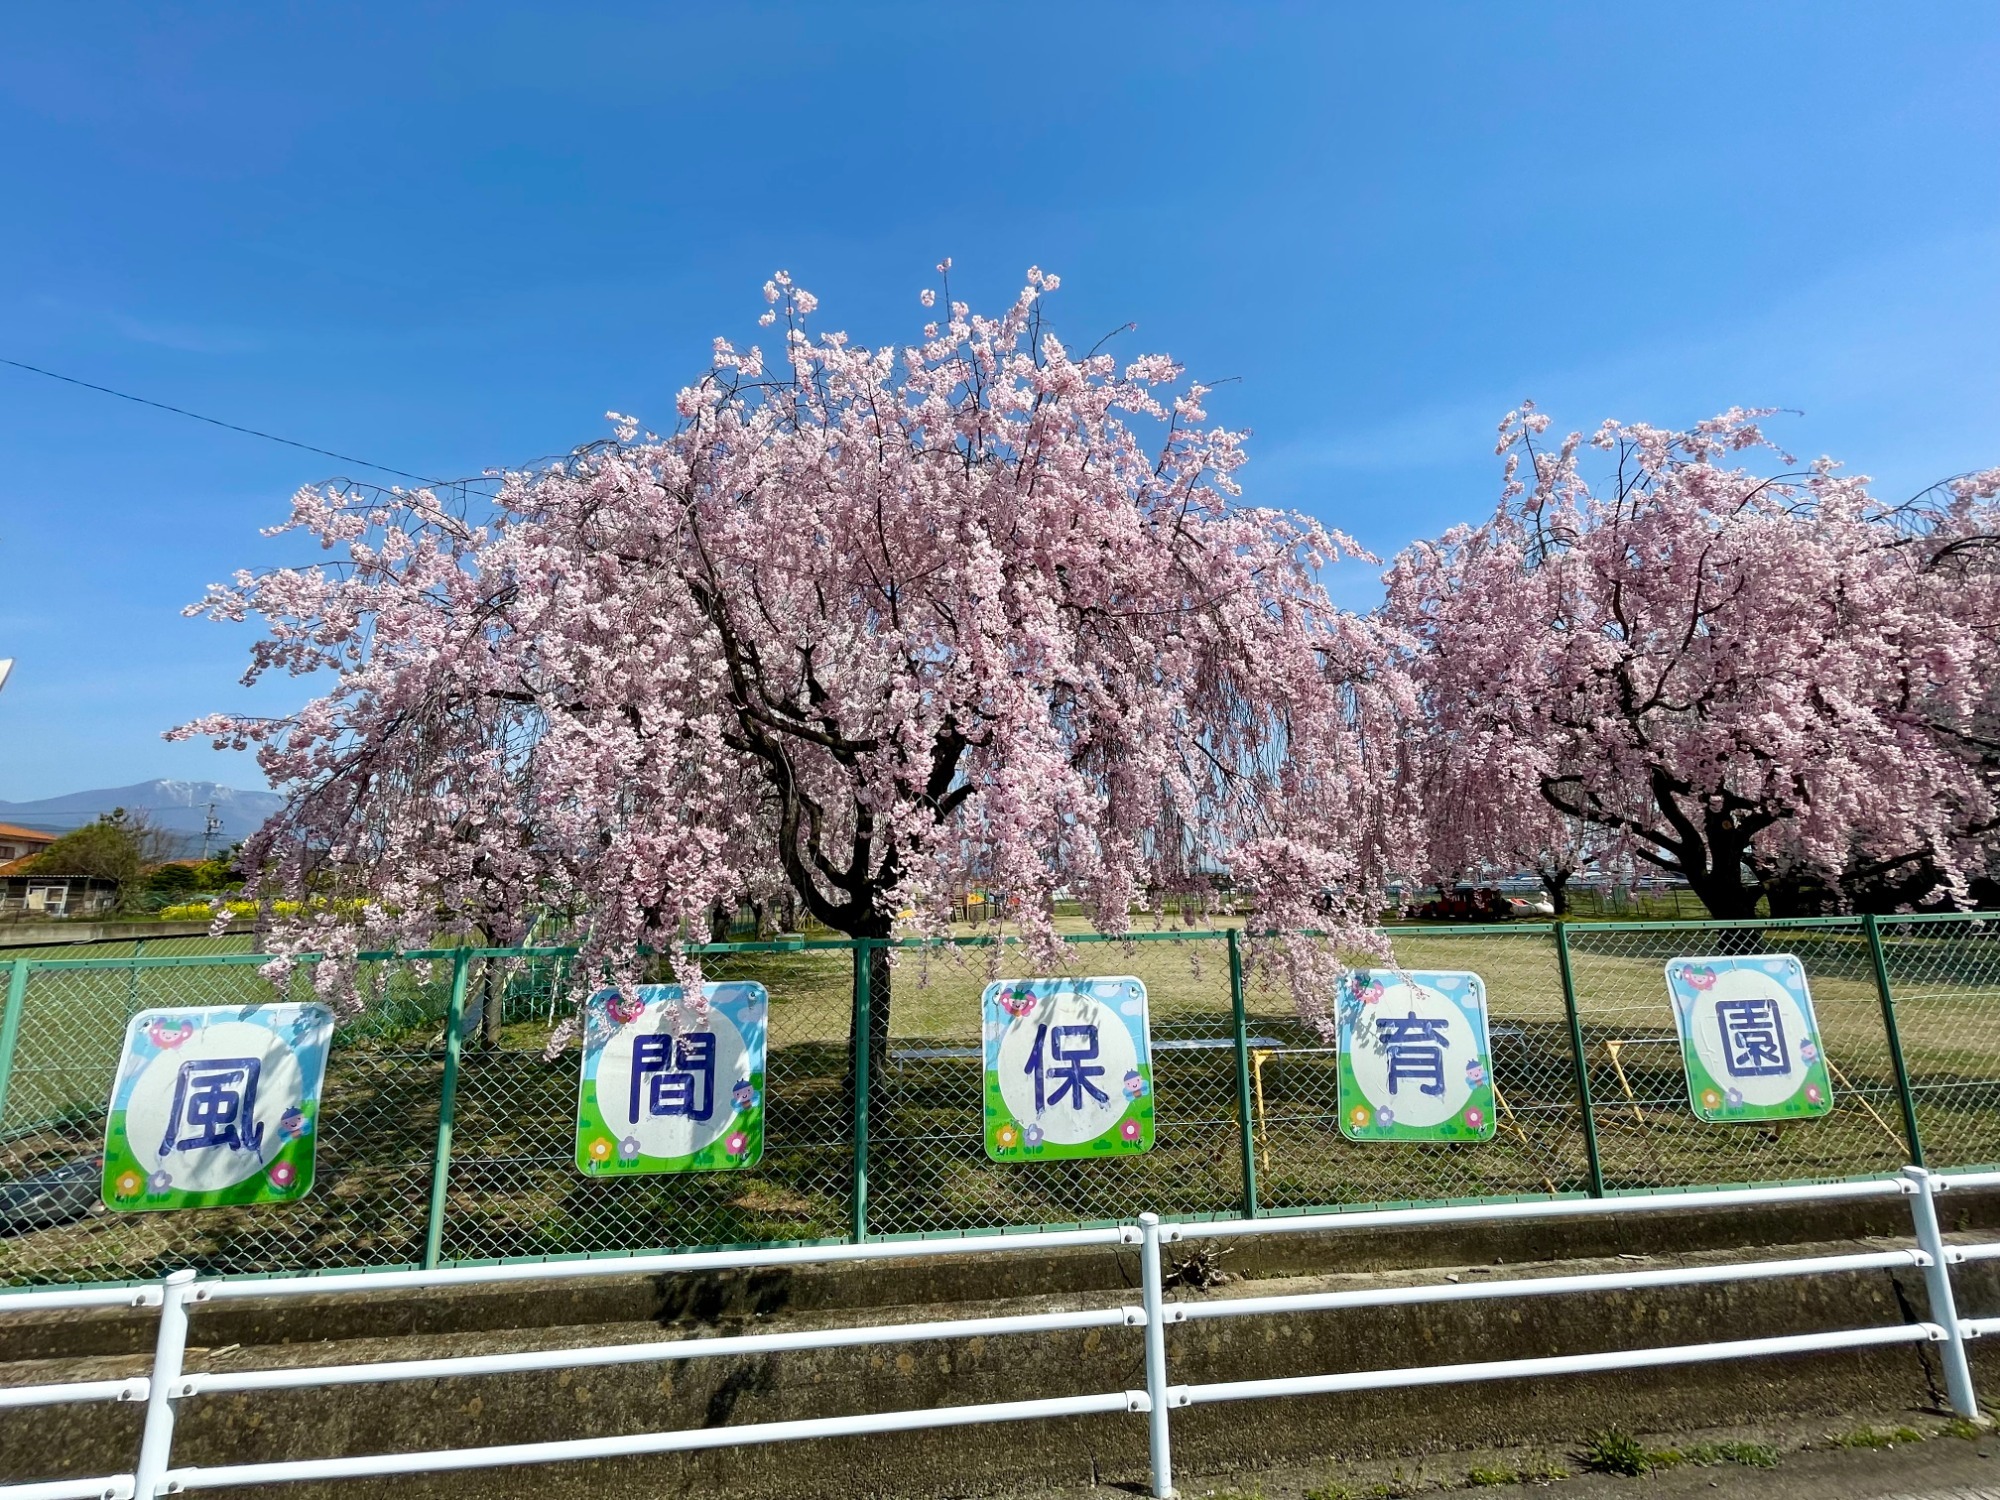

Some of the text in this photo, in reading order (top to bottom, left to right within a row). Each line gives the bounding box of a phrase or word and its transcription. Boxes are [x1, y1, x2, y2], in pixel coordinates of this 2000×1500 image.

[628, 1032, 716, 1125] 間
[1024, 1023, 1110, 1115] 保
[1376, 1011, 1450, 1096] 育
[1715, 998, 1792, 1077] 園
[158, 1057, 264, 1158] 風
